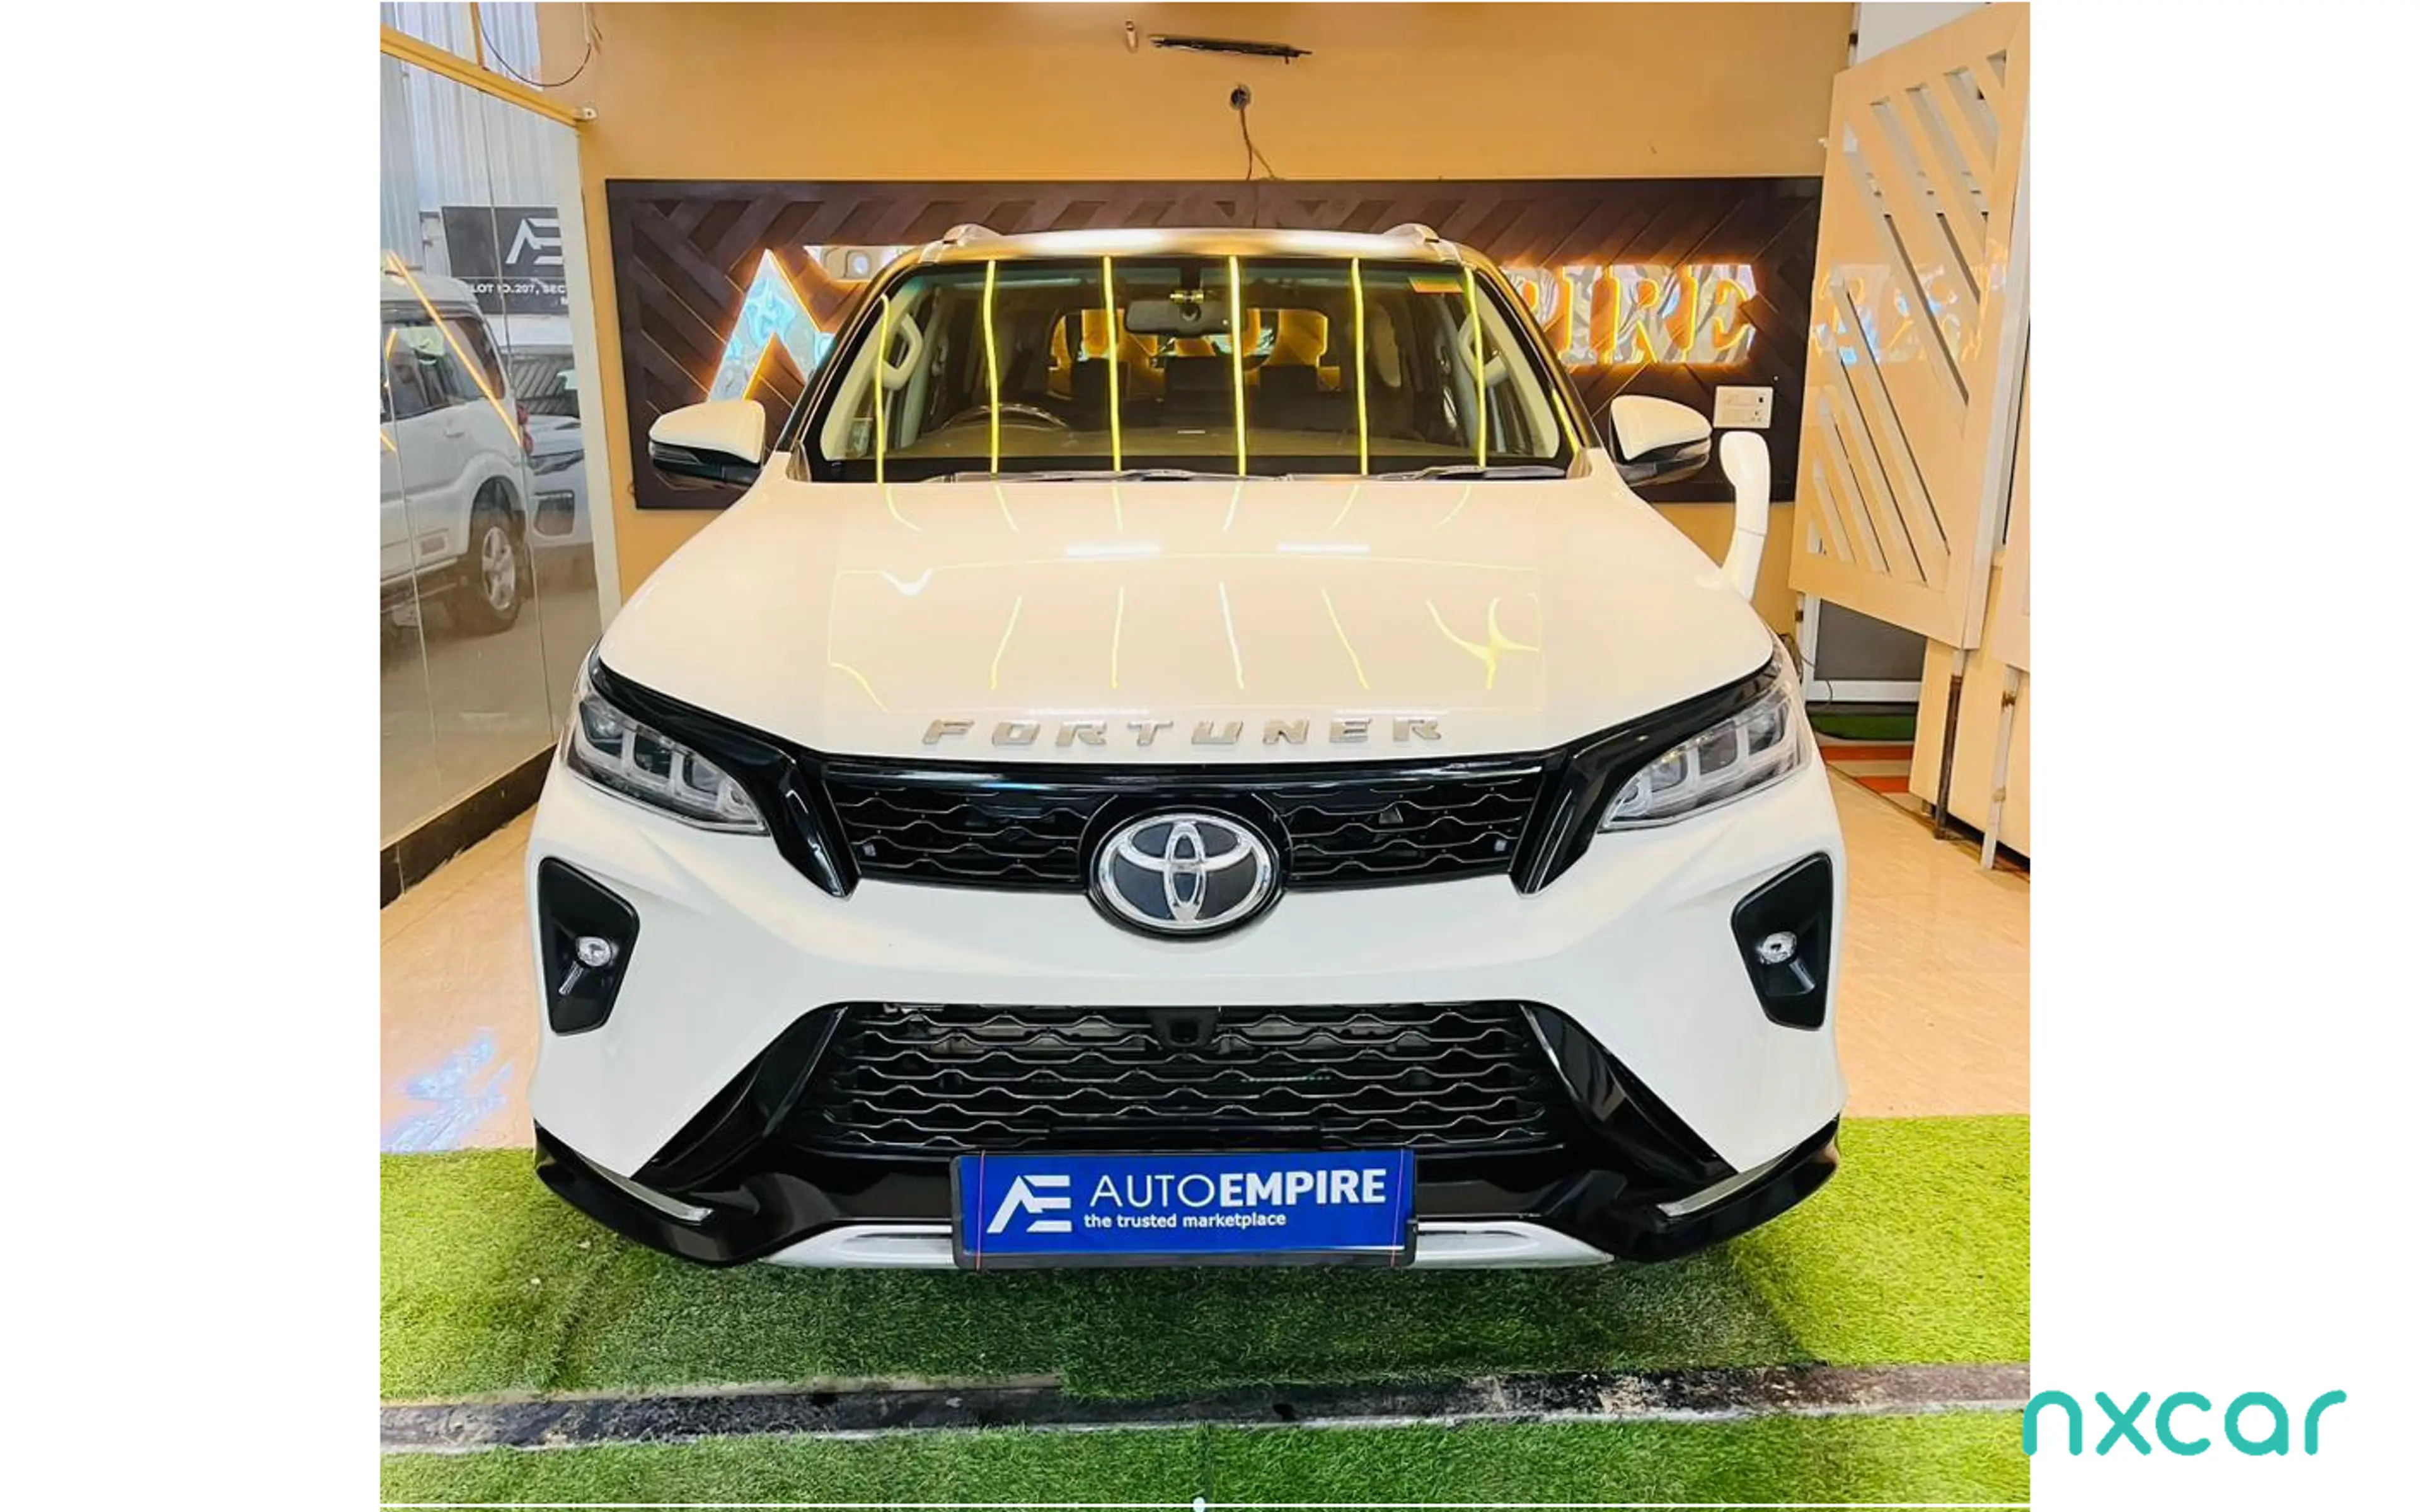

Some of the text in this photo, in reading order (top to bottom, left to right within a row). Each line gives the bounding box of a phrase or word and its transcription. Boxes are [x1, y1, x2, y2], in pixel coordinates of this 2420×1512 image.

[922, 718, 1441, 746] FORTUNER
[1090, 1168, 1386, 1208] AUTOEMPIRE
[1084, 1212, 1286, 1229] the trusted marketplace
